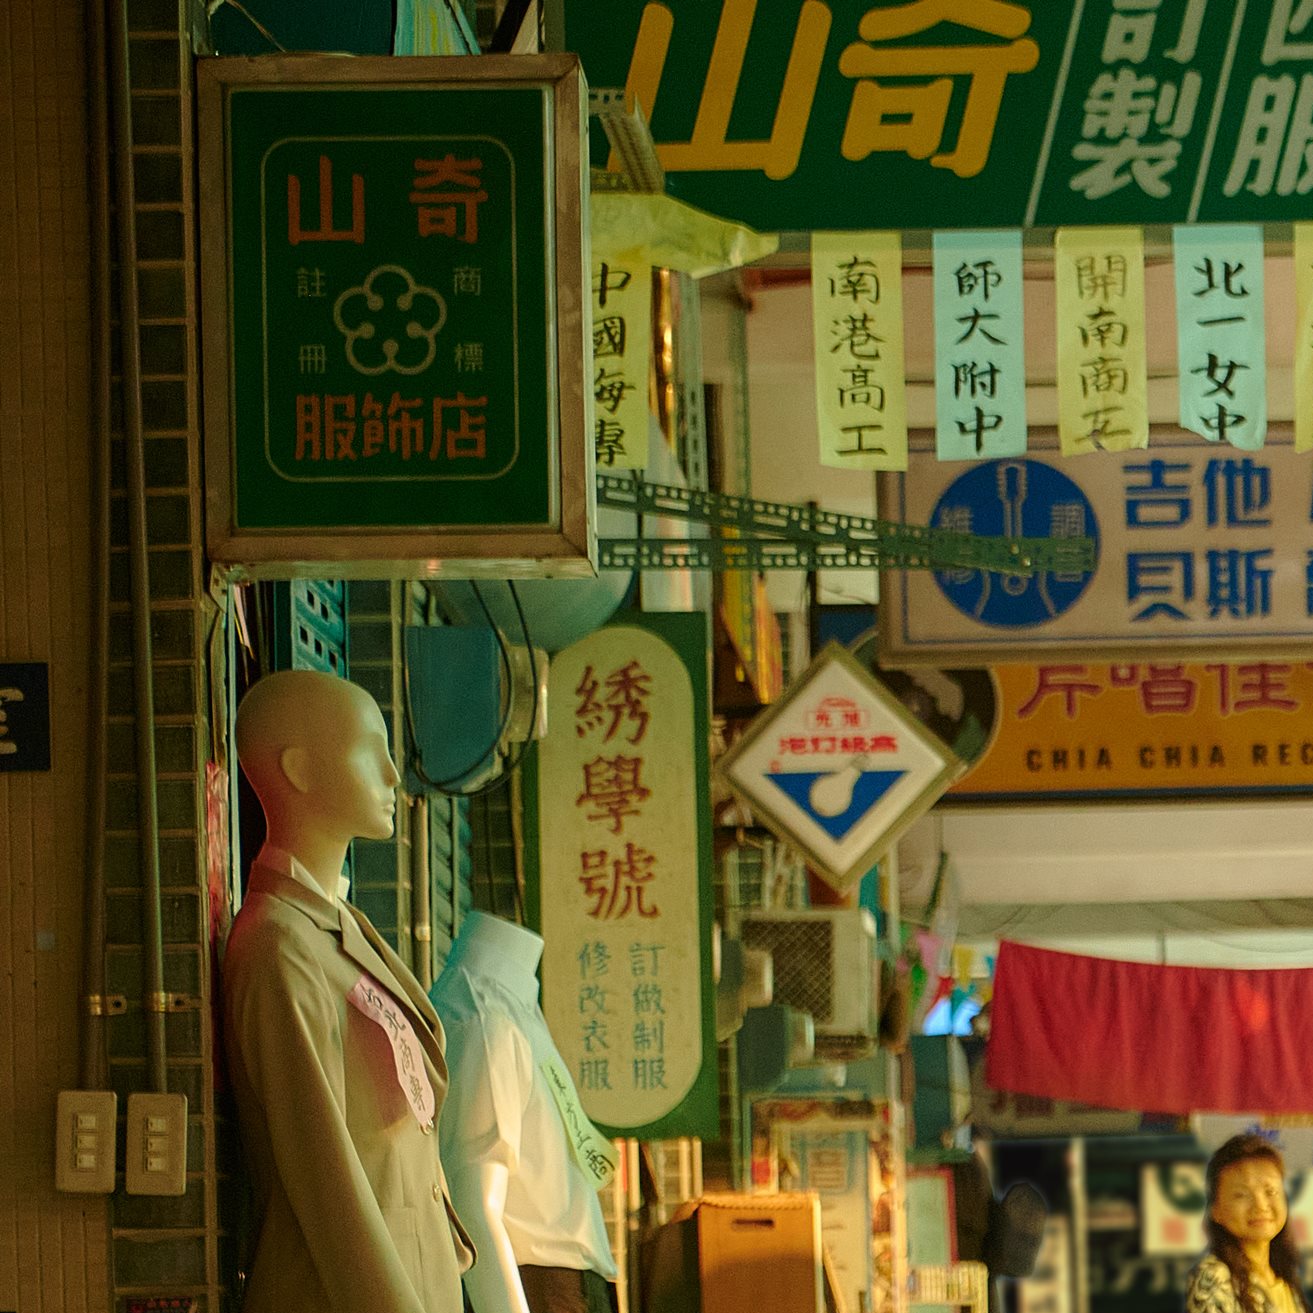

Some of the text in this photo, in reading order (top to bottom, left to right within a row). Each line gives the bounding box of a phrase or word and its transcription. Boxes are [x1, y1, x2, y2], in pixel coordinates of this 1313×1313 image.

[608, 0, 1040, 181] 山奇
[288, 155, 489, 245] 山奇
[828, 257, 886, 457] 南港高工
[951, 260, 1007, 453] 師大附中
[1191, 257, 1250, 441] 北一女中
[294, 391, 488, 461] 服飾店
[1121, 459, 1274, 529] 吉他
[1124, 547, 1276, 622] 貝斯
[1025, 746, 1112, 773] CHIA
[1137, 744, 1225, 769] CHIA
[576, 942, 615, 1091] 修改衣服
